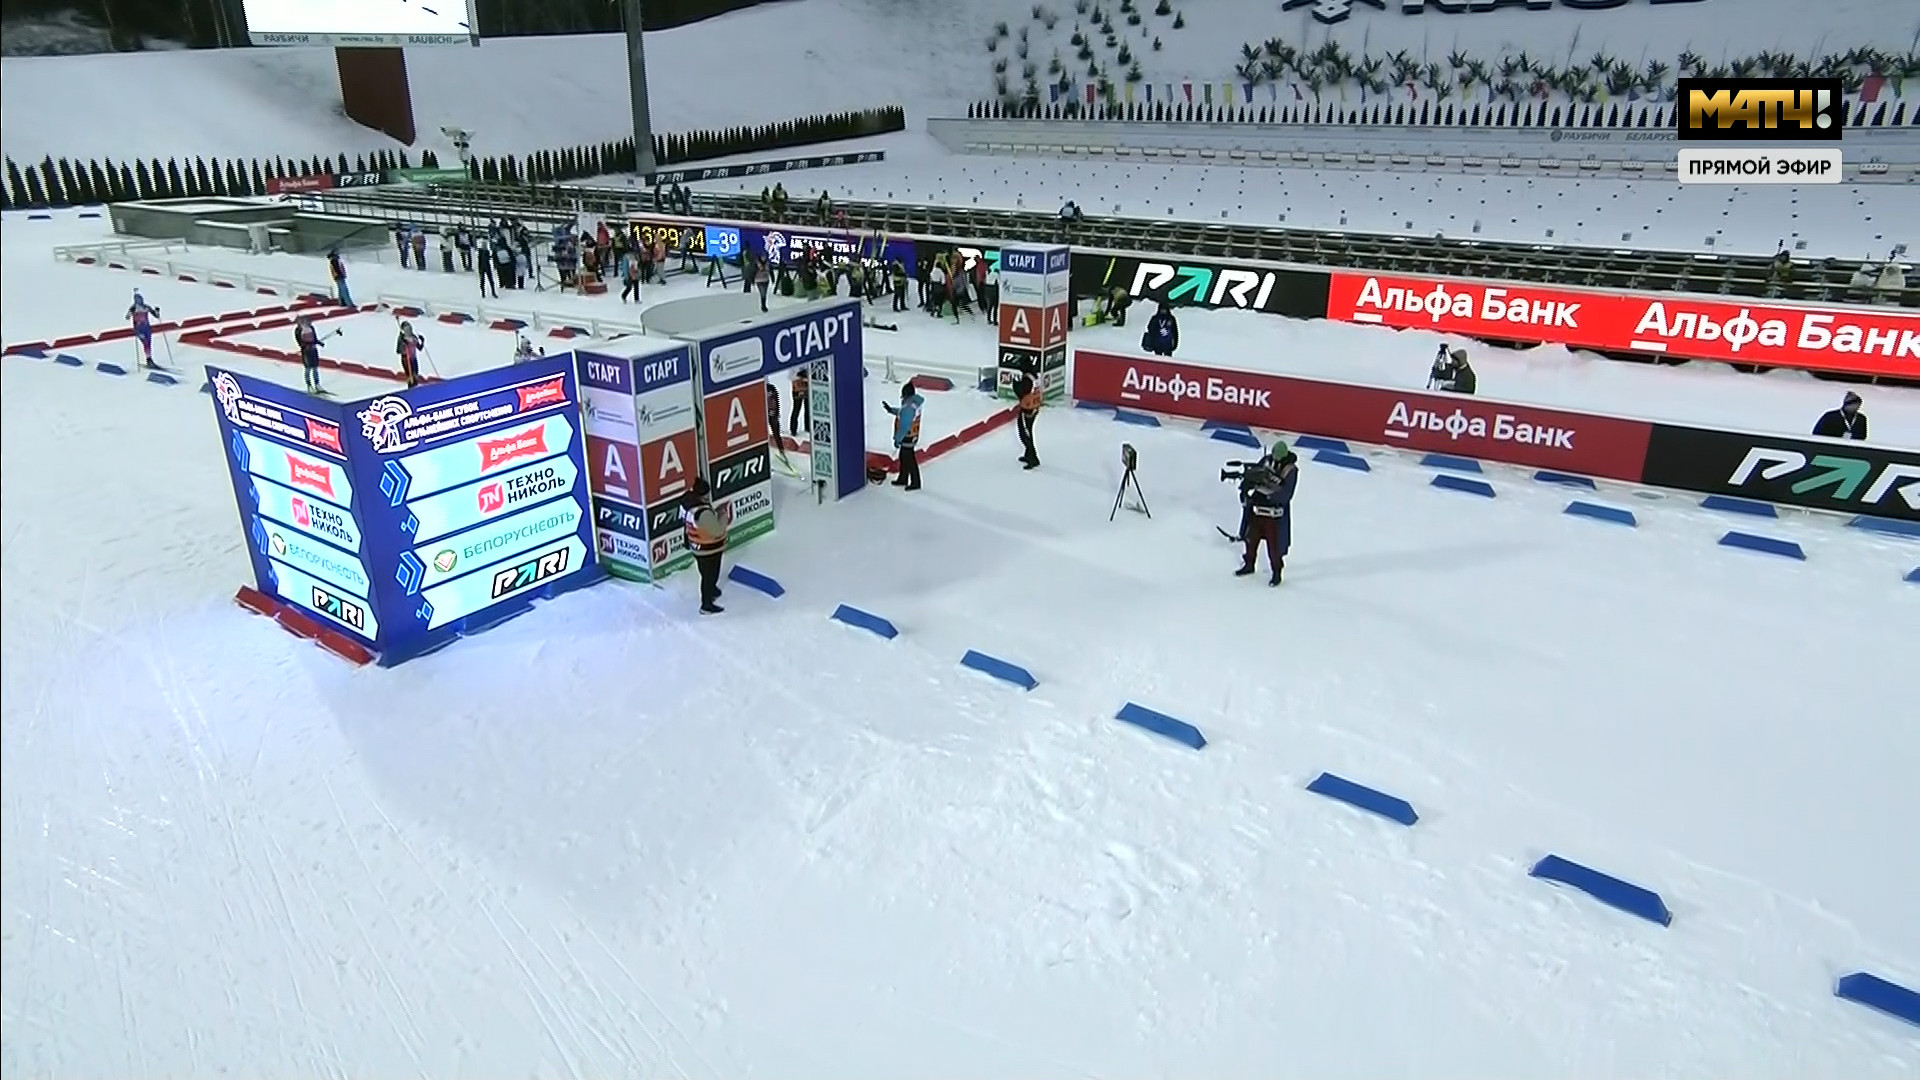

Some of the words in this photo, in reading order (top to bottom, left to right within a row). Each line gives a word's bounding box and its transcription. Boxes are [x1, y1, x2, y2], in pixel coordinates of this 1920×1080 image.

[1008, 254, 1036, 269] СТАРТ
[1130, 261, 1276, 309] PARI
[1355, 277, 1473, 321] Альфа
[1481, 288, 1581, 328] Банк
[774, 311, 854, 363] СТАРТ
[1633, 301, 1787, 352] Альфа
[1797, 314, 1920, 360] Банк
[587, 360, 621, 384] СТАРТ
[643, 357, 679, 383] СТАРТ
[1121, 366, 1201, 401] Альфа
[1206, 377, 1271, 410] Банк
[1385, 401, 1486, 440] Альфа
[1493, 414, 1575, 450] Банк
[506, 467, 554, 491] ТЕХНО
[716, 454, 765, 489] PARI
[507, 477, 566, 504] НИКОЛЬ
[734, 490, 762, 507] ТЕХНО
[309, 504, 343, 527] ТЕХНО
[600, 506, 641, 531] PARI
[735, 499, 771, 518] НИКОЛЬ
[311, 517, 353, 543] НИКОЛЬ
[669, 534, 684, 547] ТЕХ
[616, 538, 640, 553] ТЕХНО
[617, 547, 648, 564] НИКОЛЬ
[492, 547, 569, 599] PARI
[313, 587, 364, 630] PARI
